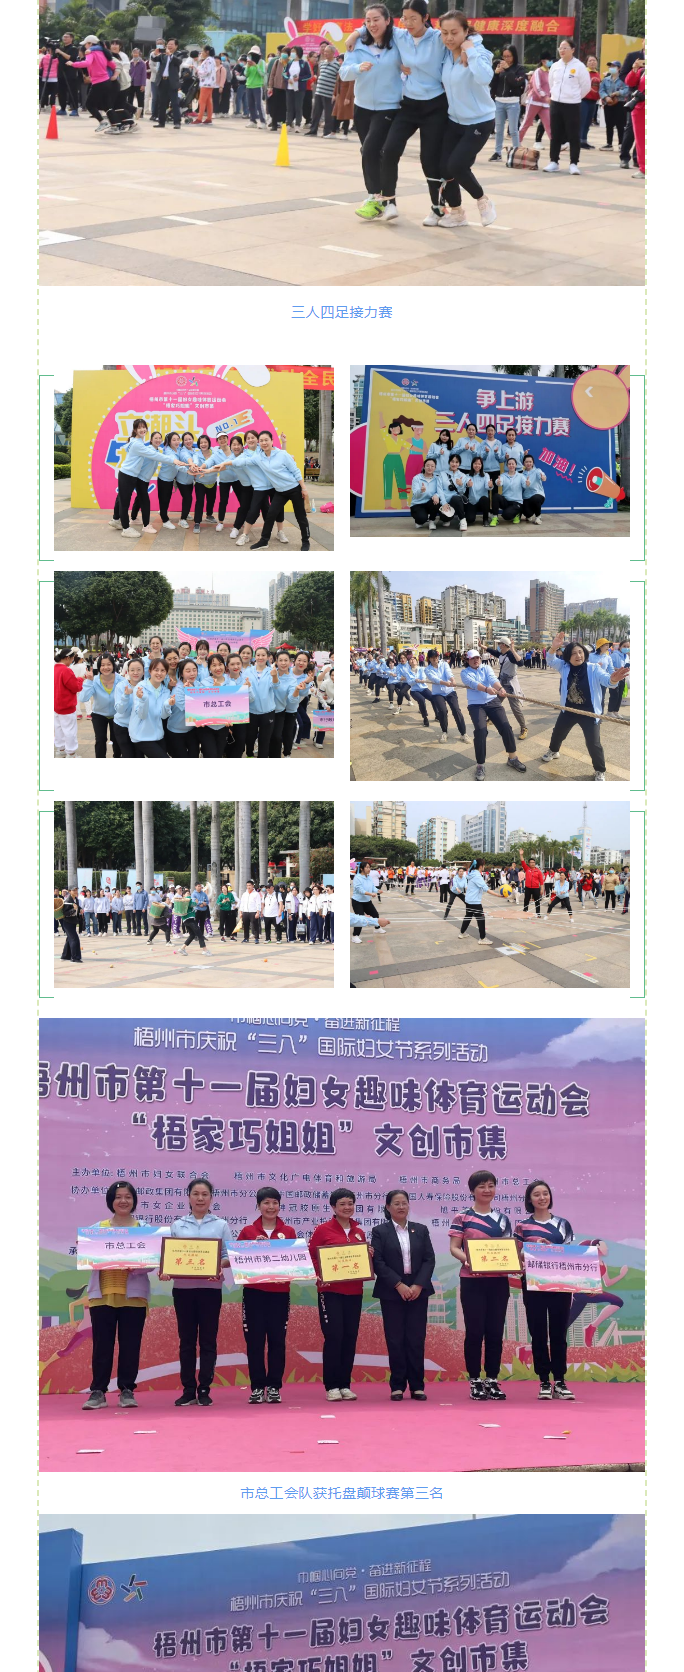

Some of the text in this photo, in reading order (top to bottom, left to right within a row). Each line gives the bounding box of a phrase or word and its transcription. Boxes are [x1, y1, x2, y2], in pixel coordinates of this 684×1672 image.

[476, 388, 535, 411] 争上游
[215, 418, 239, 434] NO.1
[434, 410, 571, 437] 三人四足接力赛
[203, 700, 232, 708] 市总工会
[234, 1172, 377, 1184] 梧州市文化广电体育和旅游局
[105, 1241, 146, 1250] 市总工会
[174, 1258, 206, 1266] 第三名
[233, 1253, 307, 1265] 梧州市第二幼儿园
[481, 1255, 509, 1263] 第二名
[332, 1262, 360, 1272] 第一名
[527, 1260, 598, 1272] 邮储银行梧州市分行
[153, 1593, 610, 1659] 梧州市第十一届妇女趣味体育运动会
